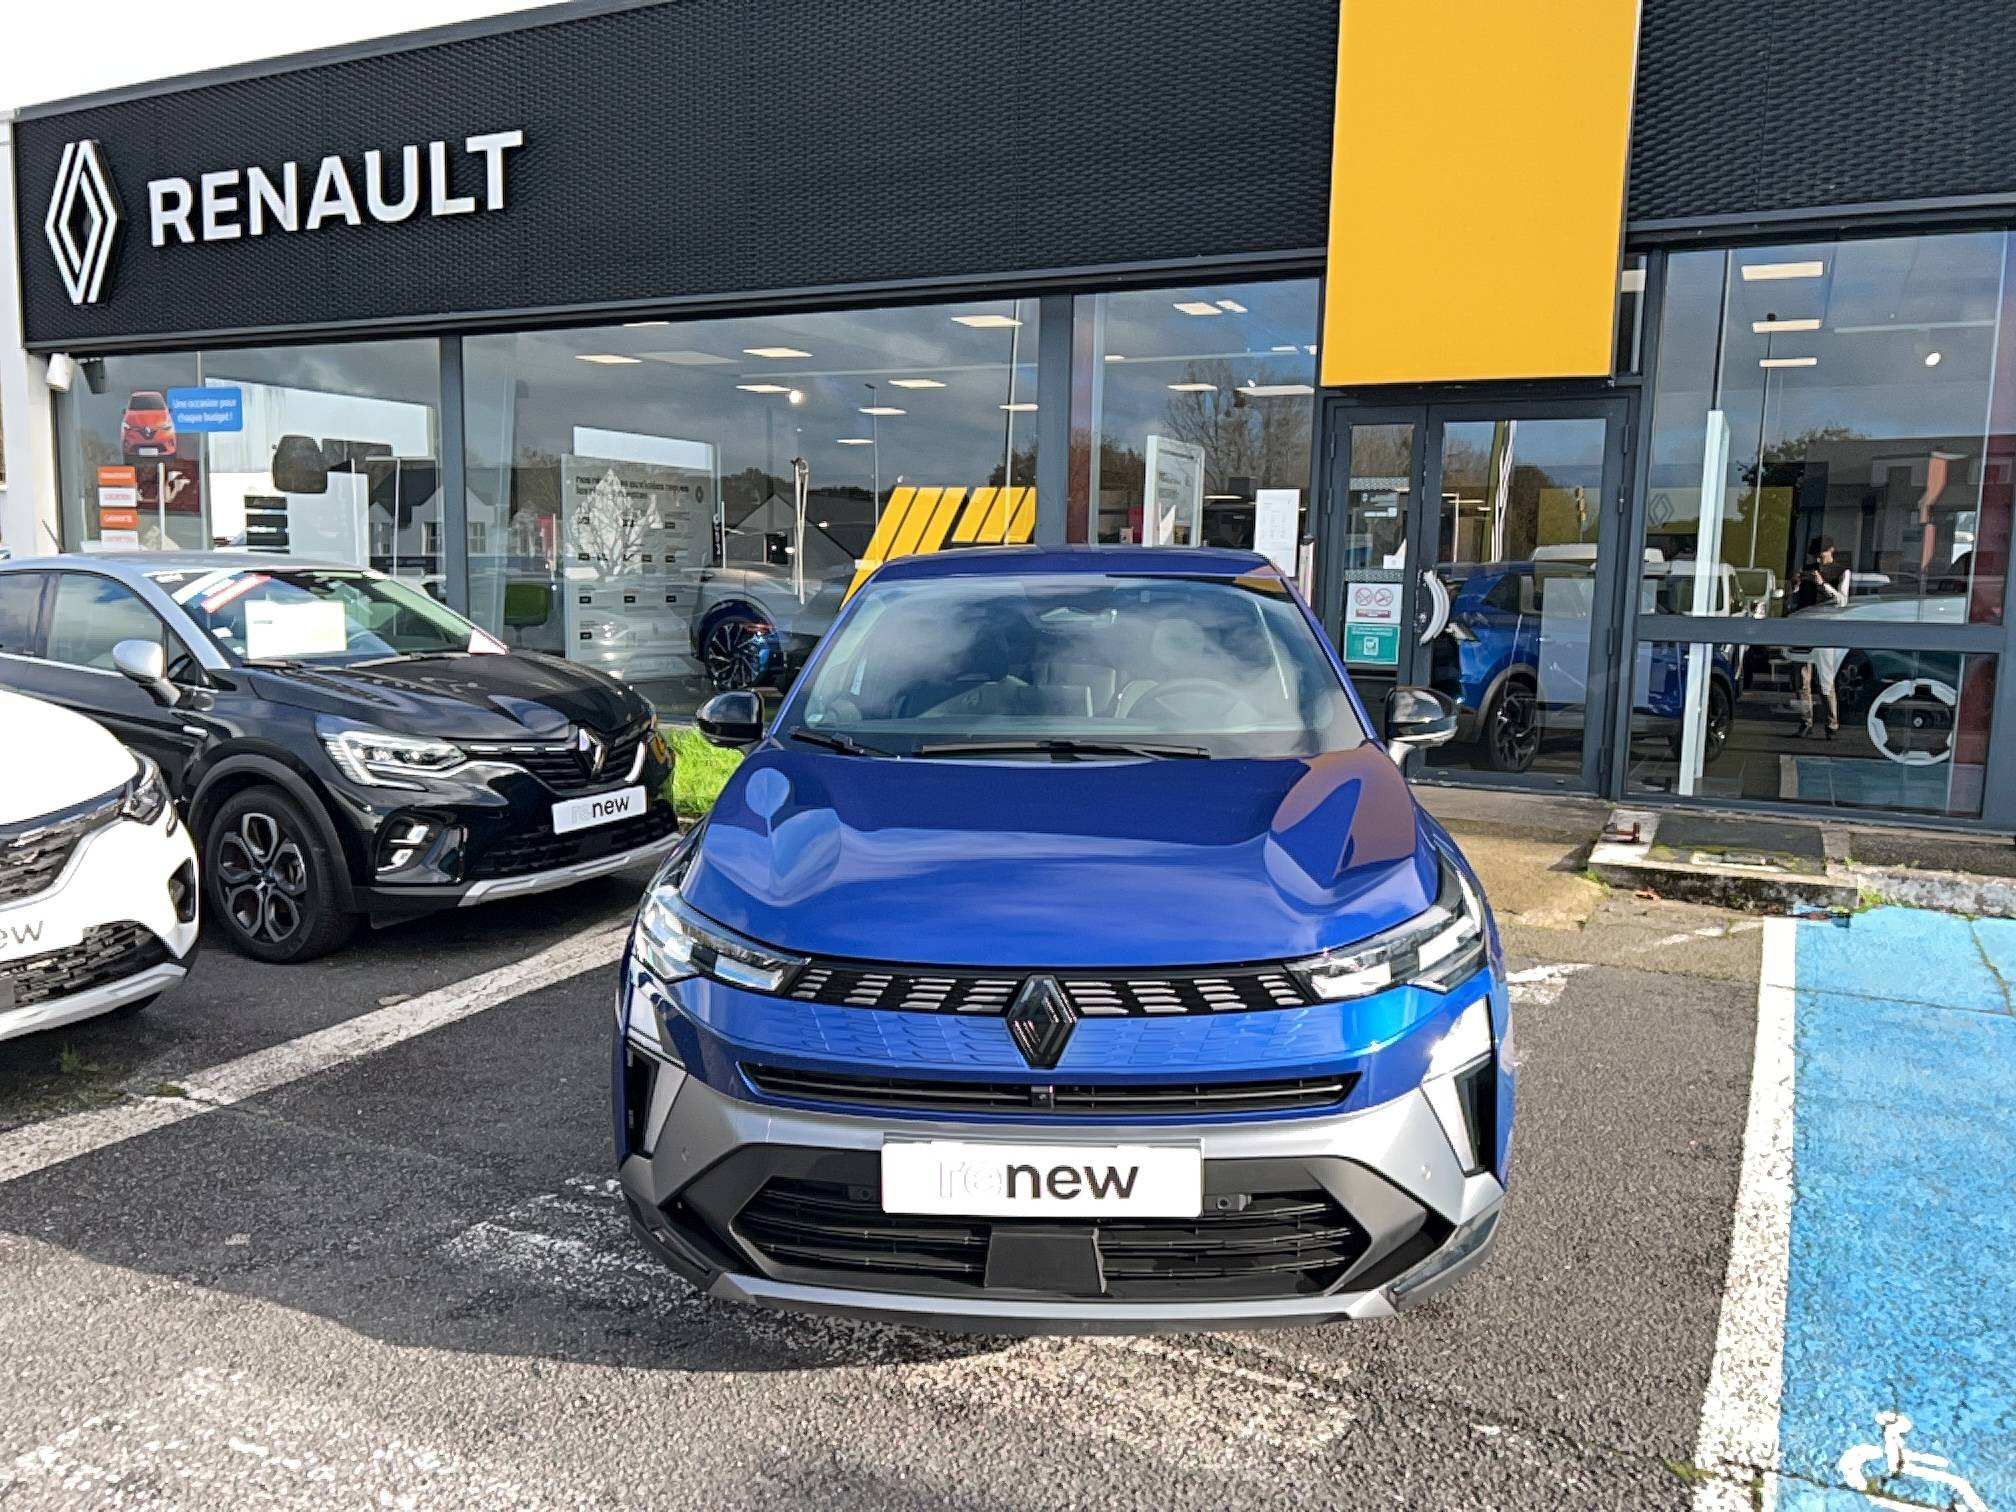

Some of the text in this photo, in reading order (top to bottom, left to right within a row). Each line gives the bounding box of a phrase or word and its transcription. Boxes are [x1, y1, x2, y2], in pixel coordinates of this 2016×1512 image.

[147, 129, 524, 248] RENAULT
[172, 398, 237, 409] Une occasion pour
